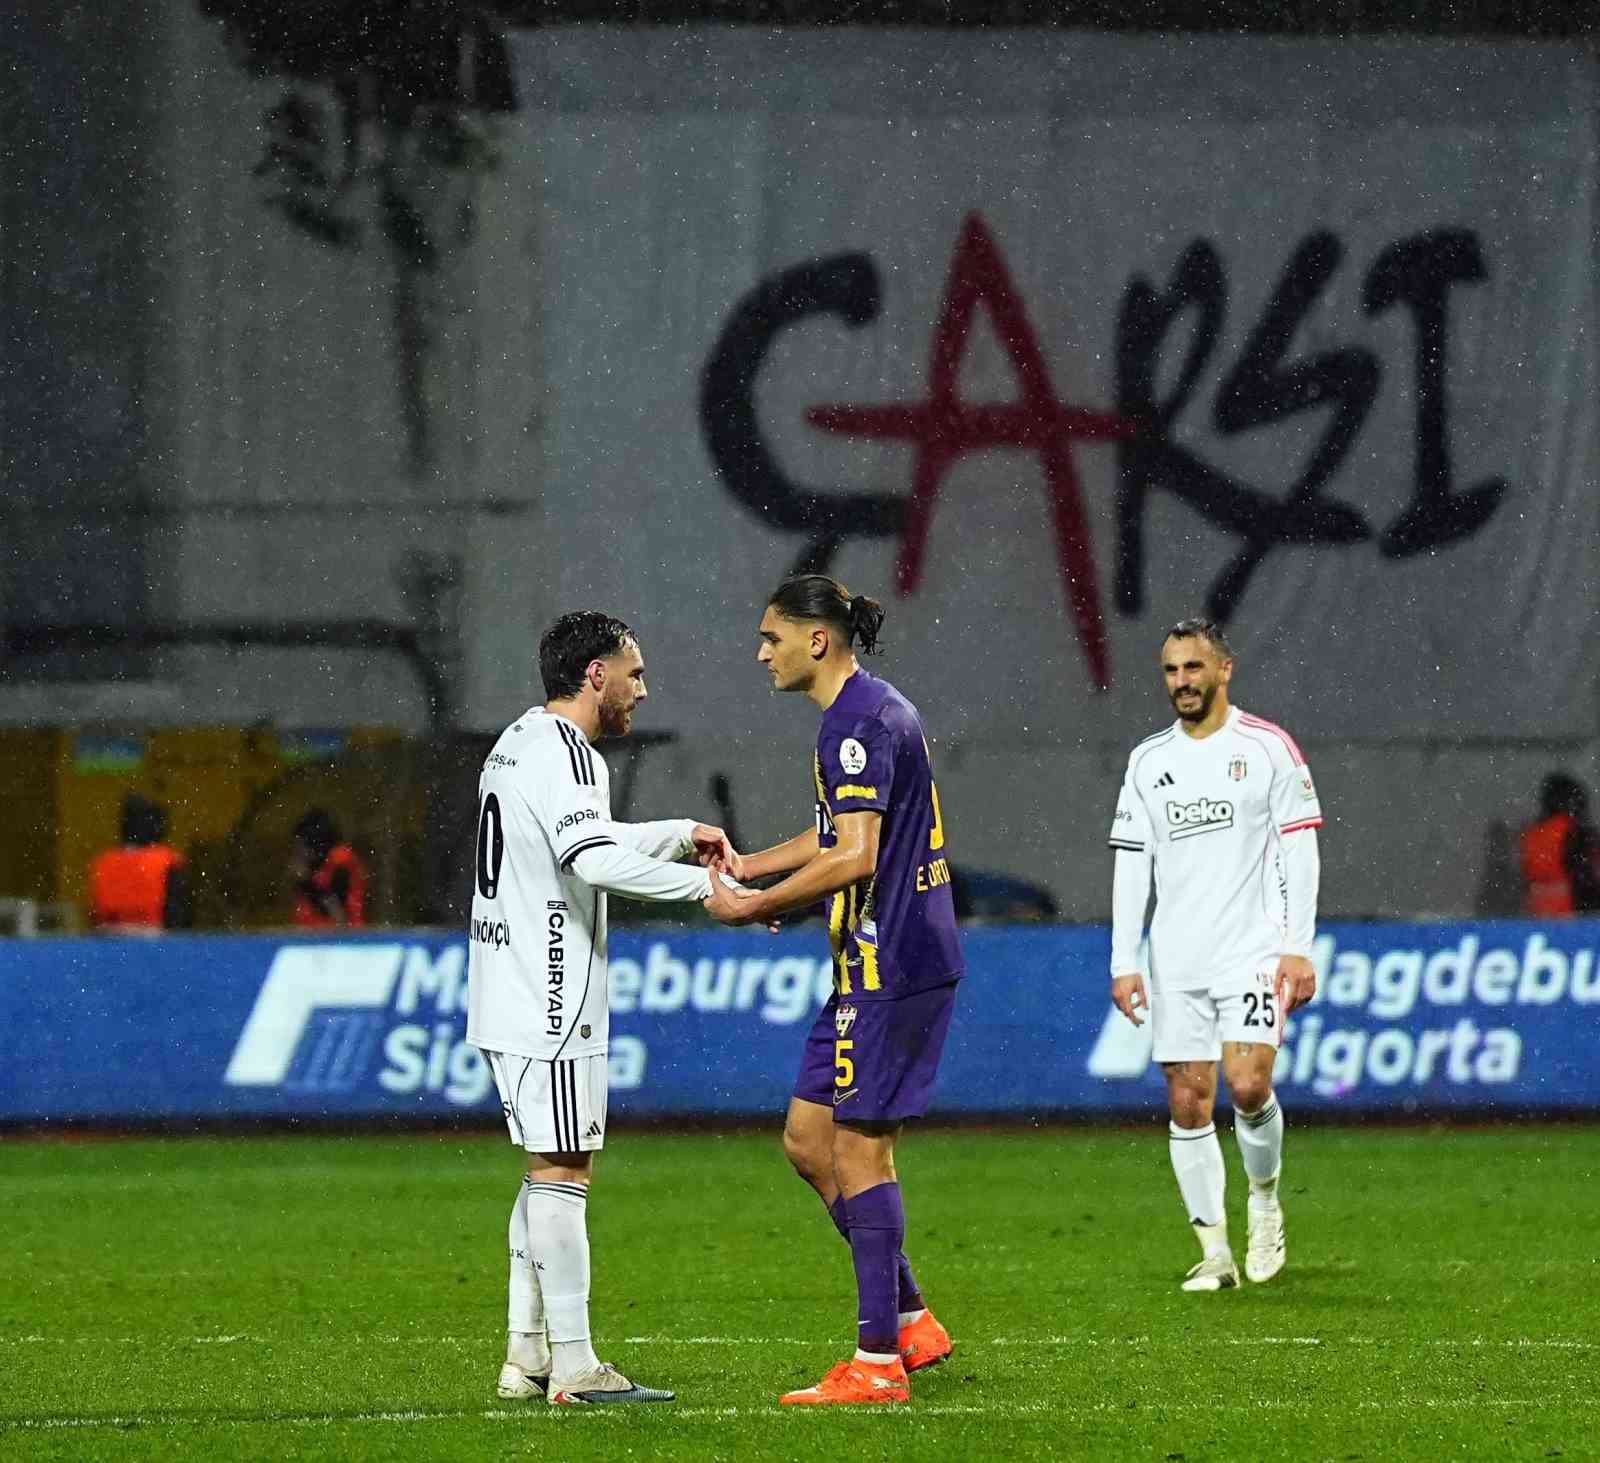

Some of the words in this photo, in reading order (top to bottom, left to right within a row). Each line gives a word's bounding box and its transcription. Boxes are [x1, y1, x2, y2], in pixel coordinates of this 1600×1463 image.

[1167, 798, 1234, 825] beko
[1243, 991, 1275, 1028] 25
[834, 1040, 854, 1088] 5
